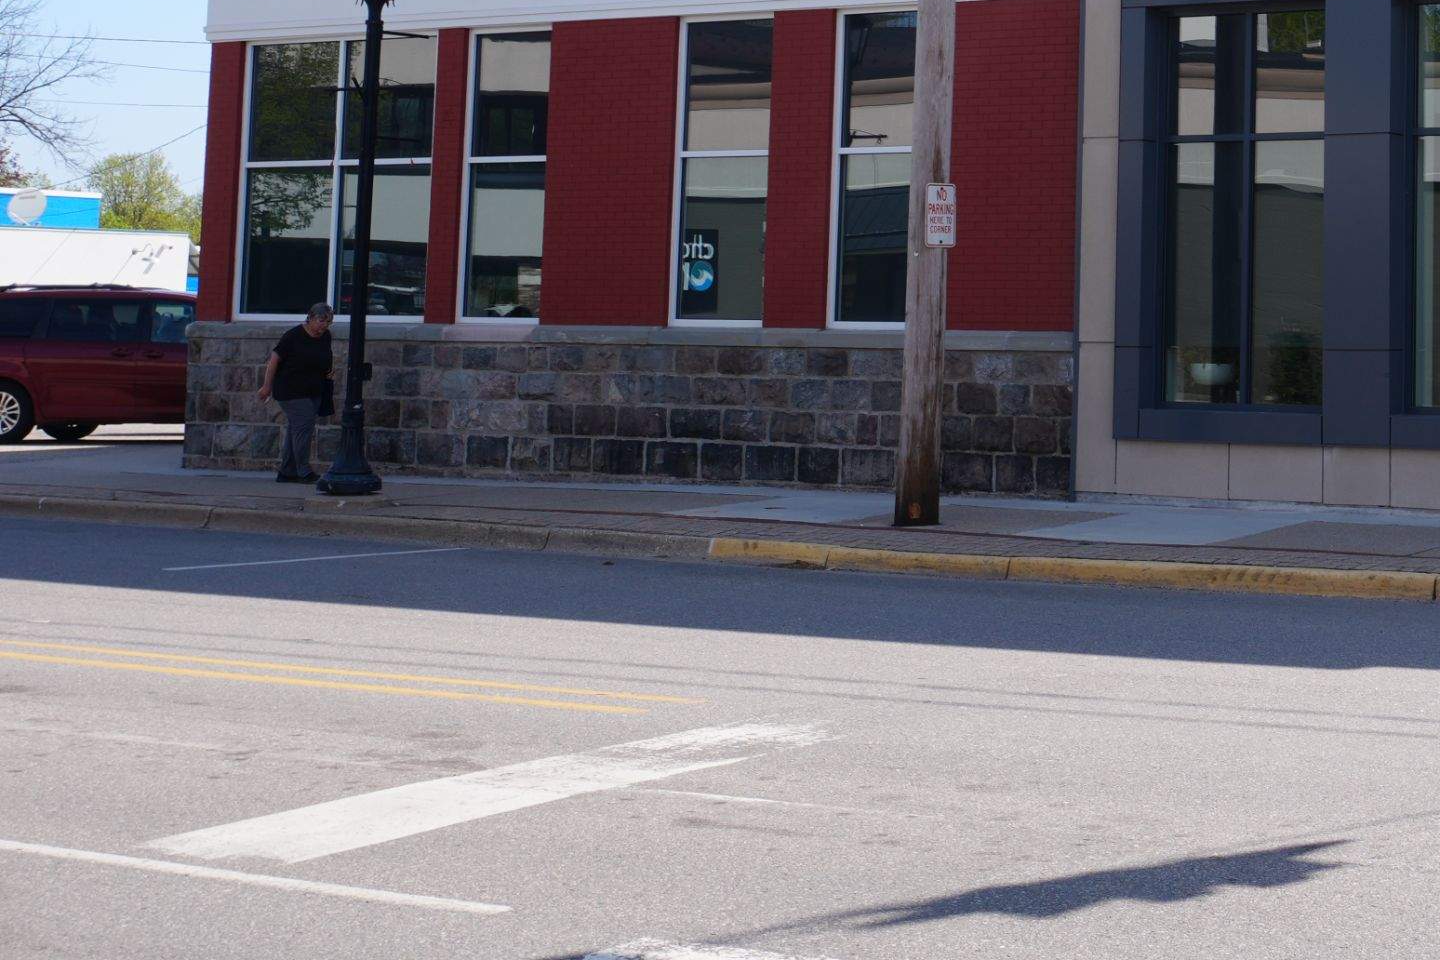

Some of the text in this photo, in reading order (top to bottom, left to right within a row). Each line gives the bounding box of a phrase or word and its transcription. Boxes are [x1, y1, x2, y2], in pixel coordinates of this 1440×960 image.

[937, 190, 948, 201] NO
[928, 203, 954, 215] PARKING
[930, 216, 953, 225] HERE TO
[929, 225, 952, 234] CORNER
